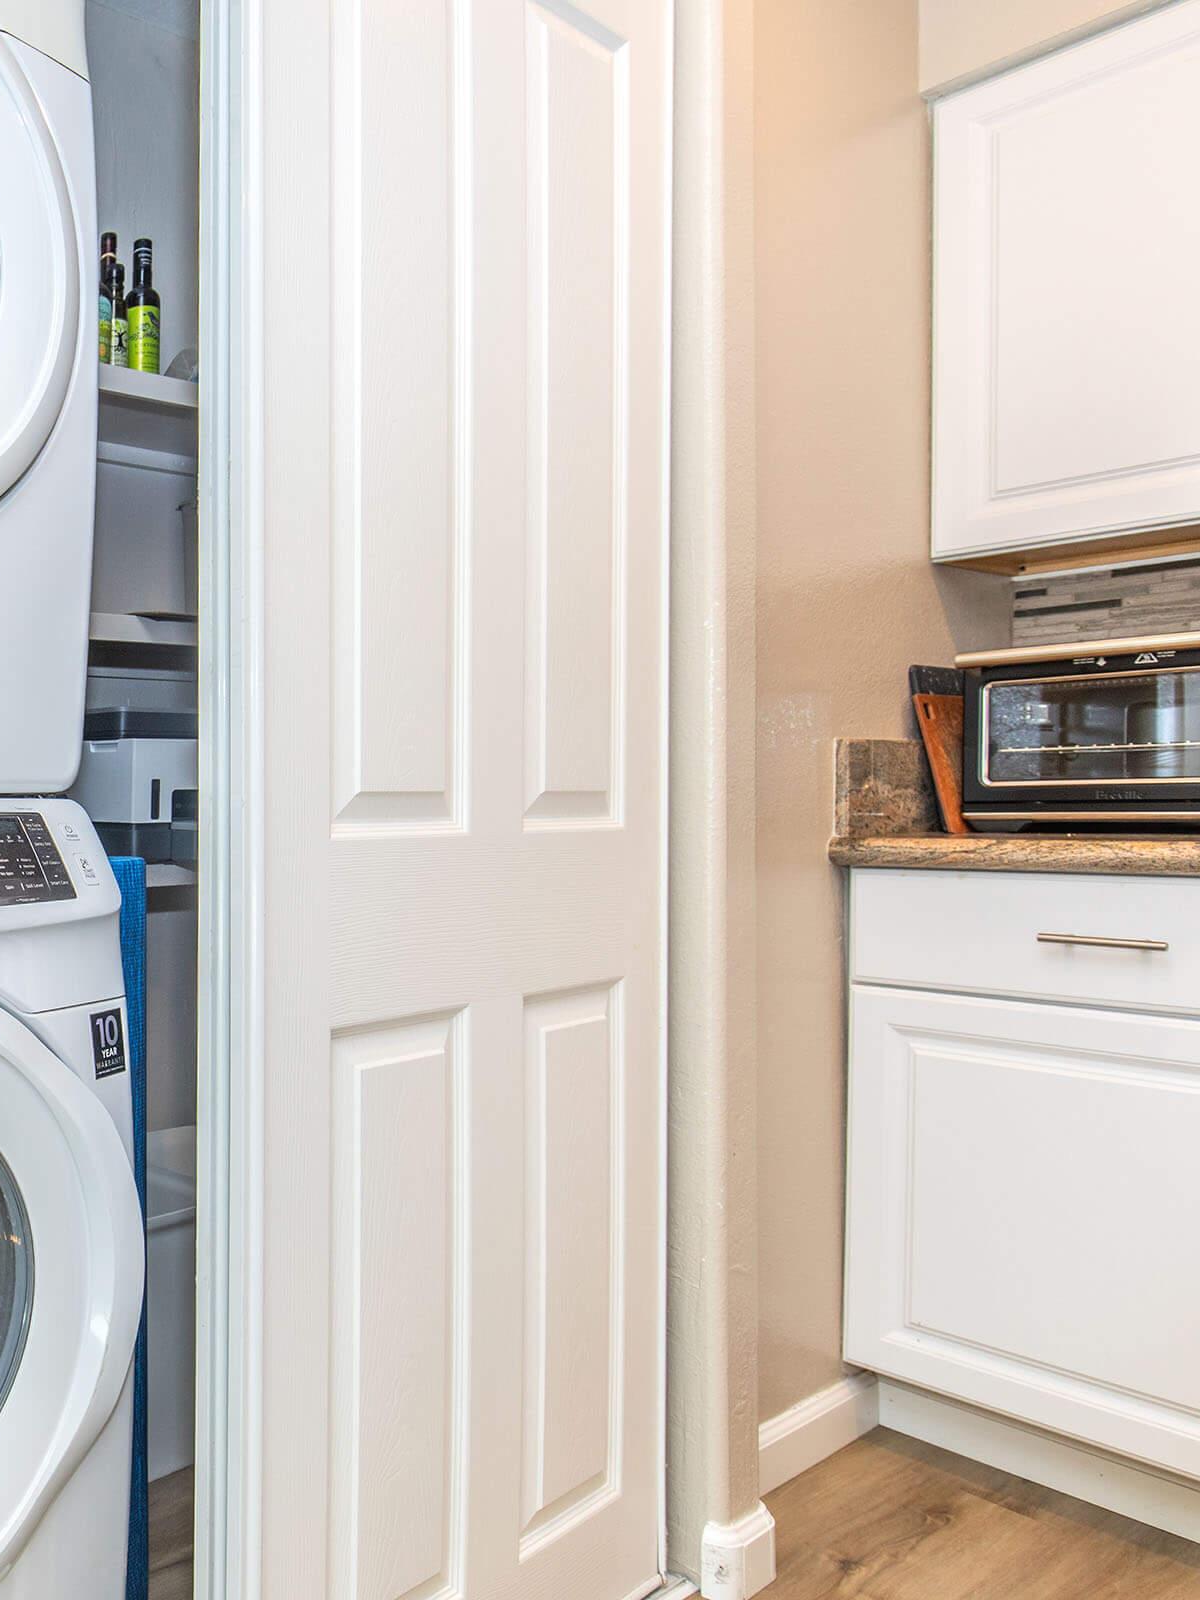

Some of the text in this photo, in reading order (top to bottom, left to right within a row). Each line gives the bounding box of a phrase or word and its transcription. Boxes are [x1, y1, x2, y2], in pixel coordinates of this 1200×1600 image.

[1095, 790, 1144, 800] Breville
[95, 1015, 118, 1047] 10
[101, 1047, 117, 1058] YEAR
